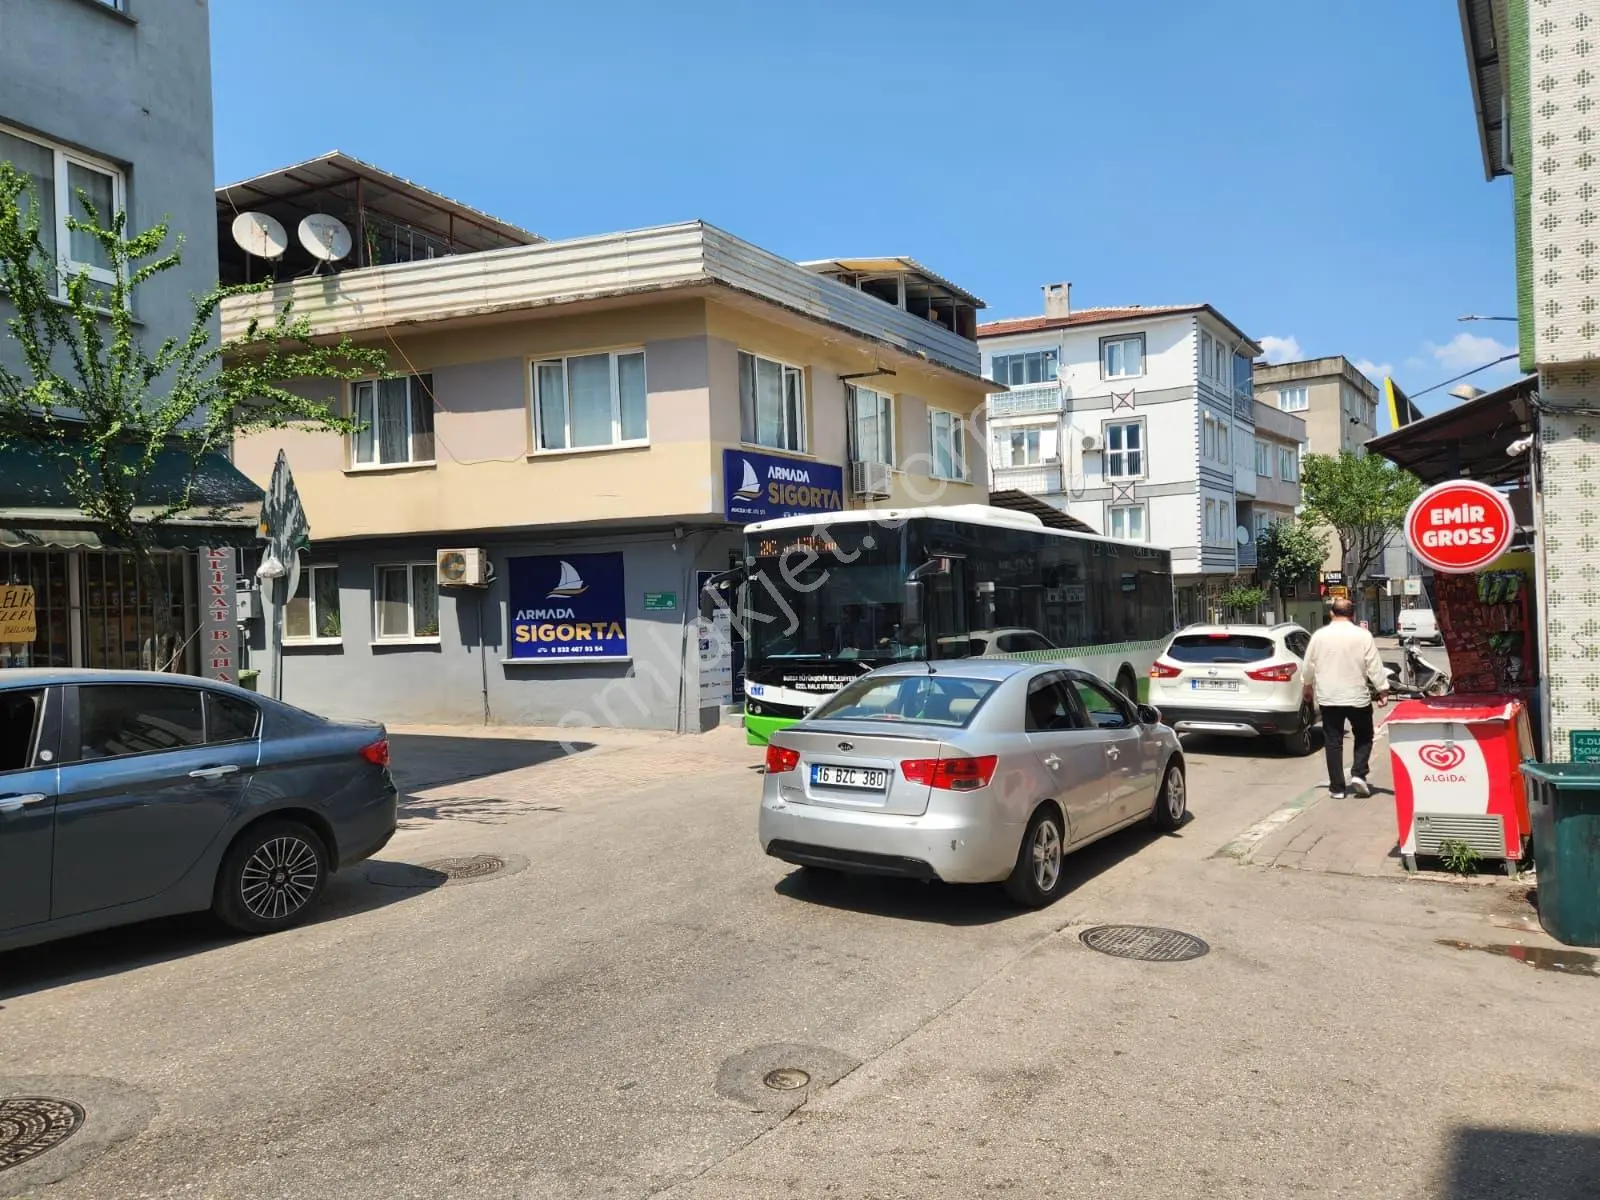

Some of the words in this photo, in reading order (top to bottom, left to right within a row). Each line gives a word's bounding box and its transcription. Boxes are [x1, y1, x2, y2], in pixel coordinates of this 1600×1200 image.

[767, 465, 810, 483] ARMADA
[768, 482, 841, 510] SIGORTA
[1430, 503, 1485, 526] EMİR
[1422, 526, 1496, 548] GROSS
[0, 588, 34, 609] ELİK
[515, 608, 575, 620] ARMADA
[515, 622, 625, 643] SIGORTA
[1577, 747, 1600, 755] SOK
[818, 767, 830, 782] 16
[835, 769, 857, 784] BZC
[862, 770, 884, 787] 380
